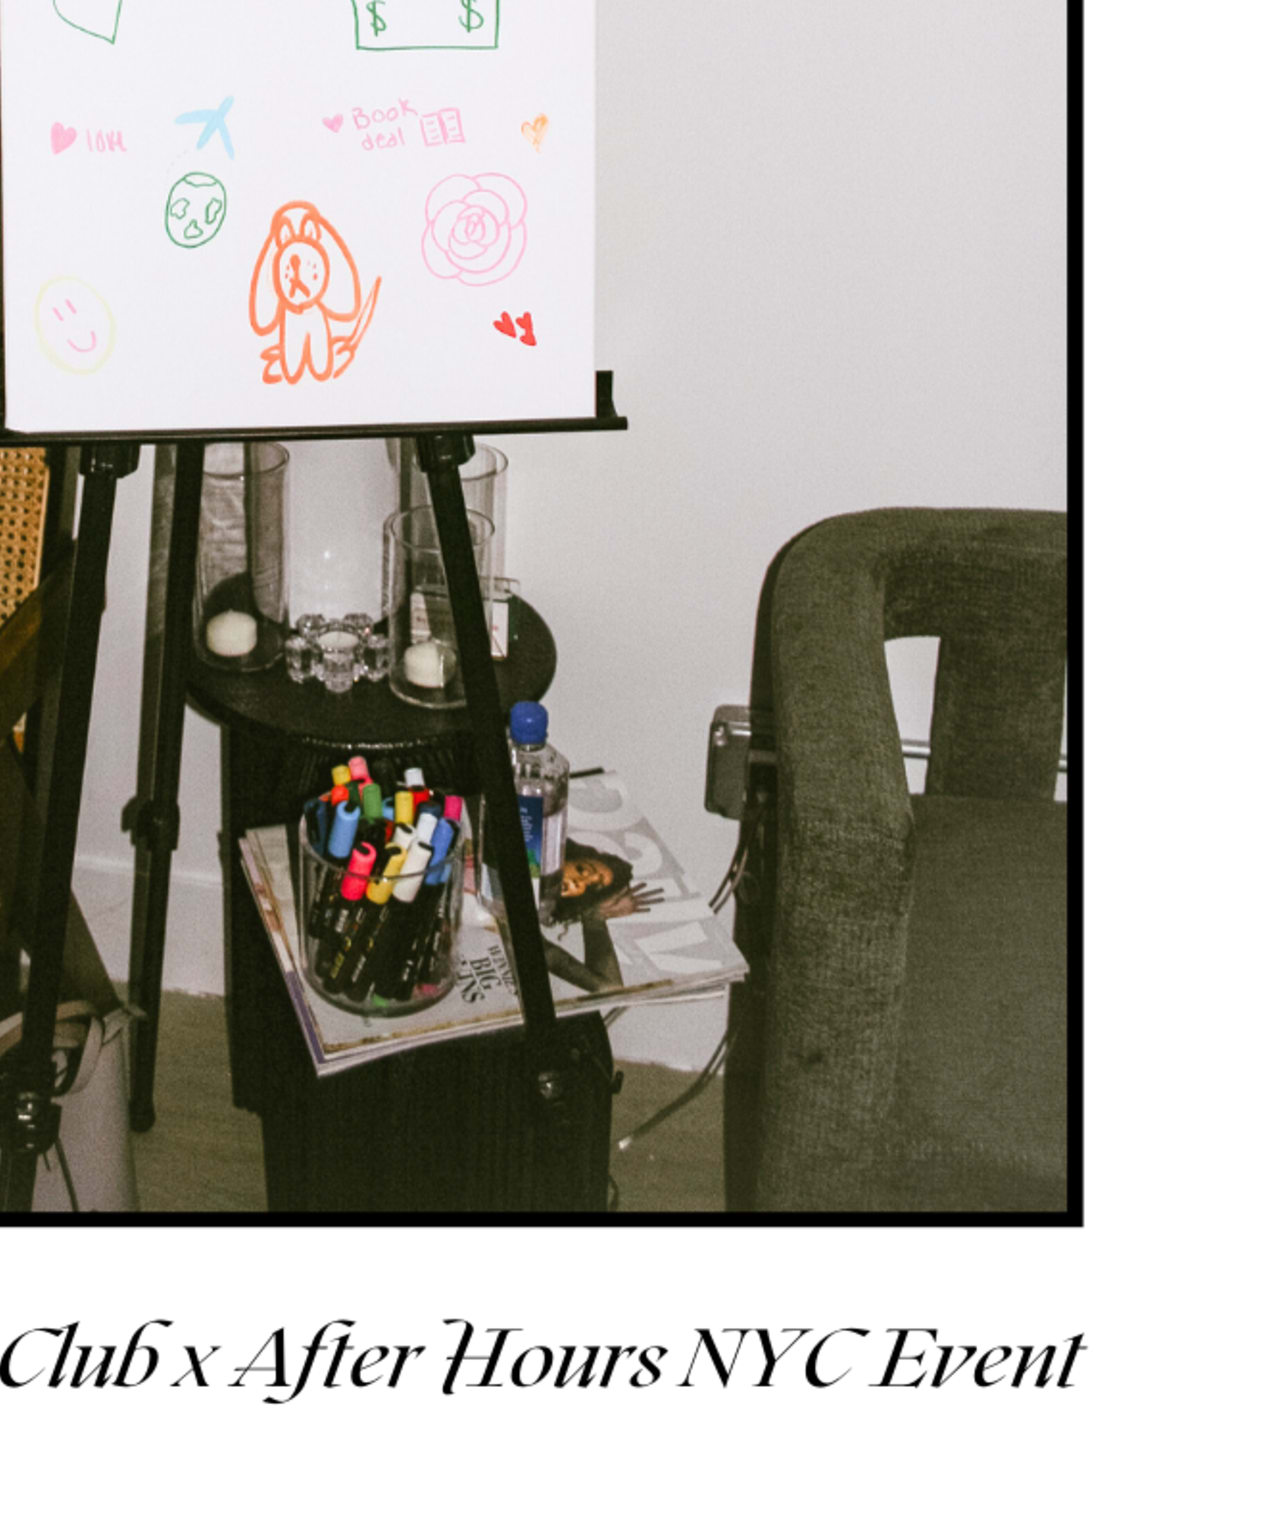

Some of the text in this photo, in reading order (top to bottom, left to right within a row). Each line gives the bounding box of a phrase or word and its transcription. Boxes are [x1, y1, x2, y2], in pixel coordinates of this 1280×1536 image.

[352, 97, 418, 131] Book
[361, 126, 406, 152] deal
[469, 957, 502, 990] BIG
